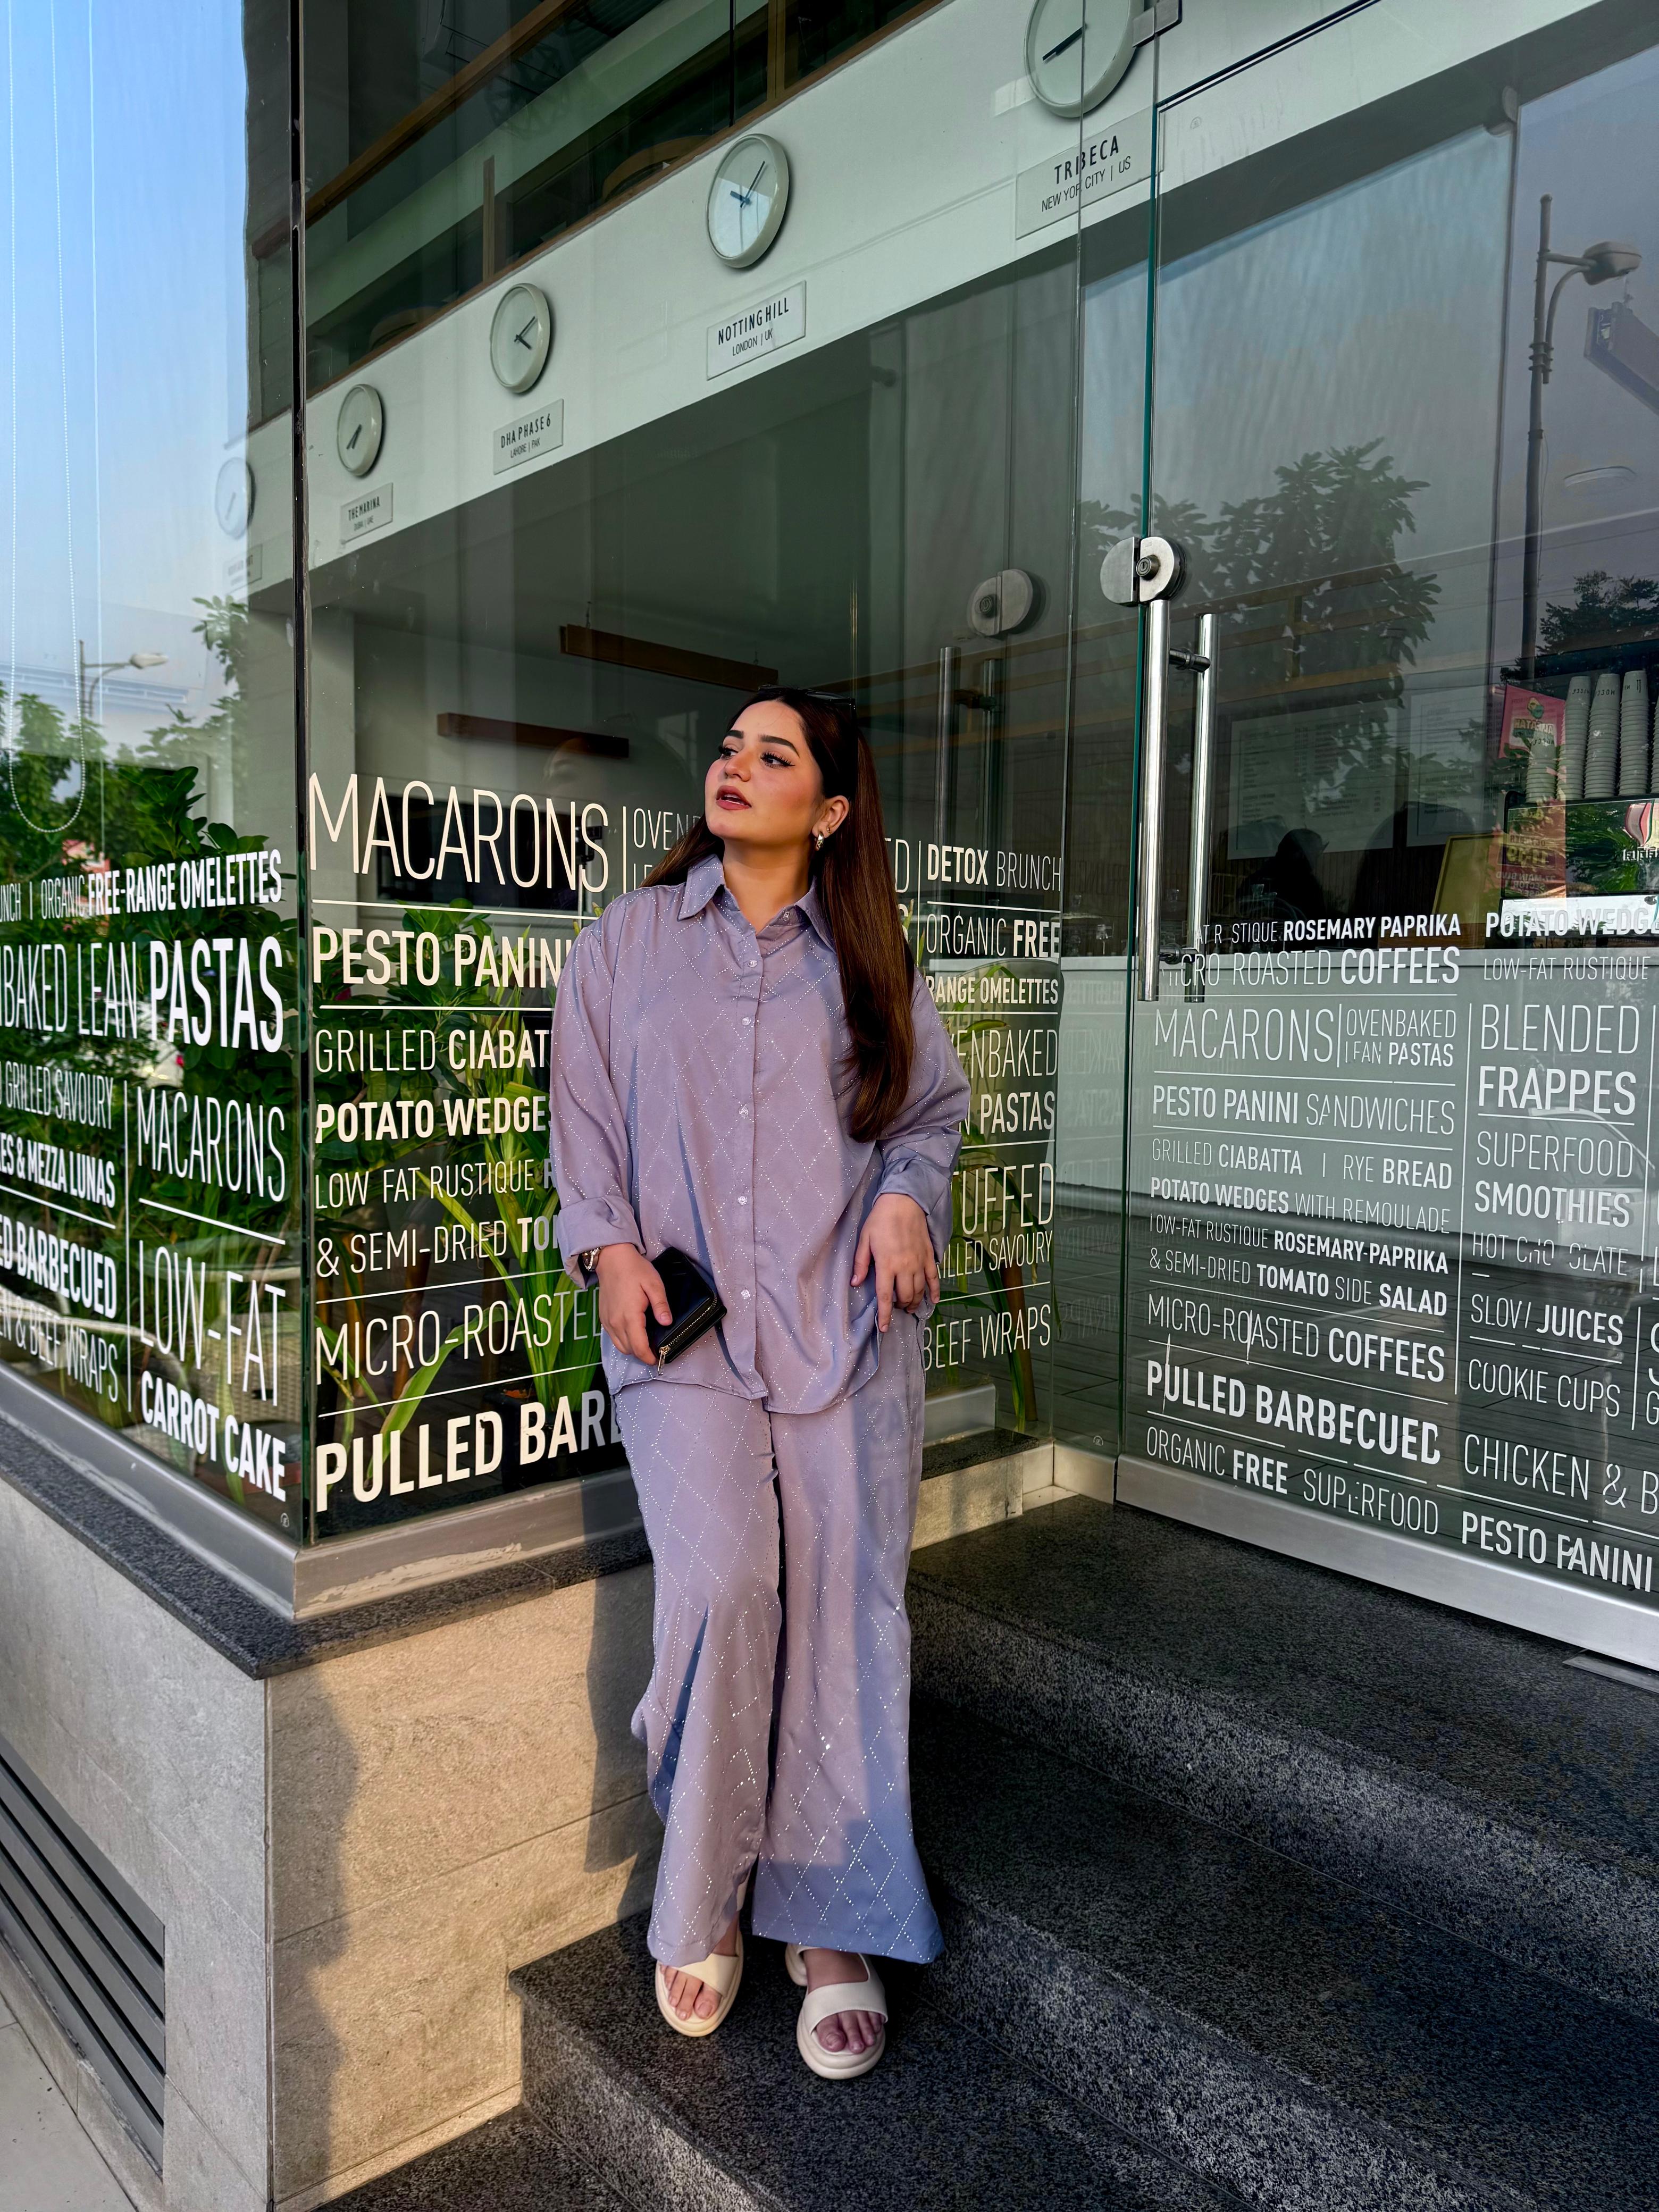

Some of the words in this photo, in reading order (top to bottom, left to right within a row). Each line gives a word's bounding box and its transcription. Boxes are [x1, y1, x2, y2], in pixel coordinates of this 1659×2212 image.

[1041, 192, 1061, 212] NEW
[1085, 169, 1105, 189] CITY
[1119, 156, 1131, 173] US
[1054, 136, 1119, 184] TRIBECA
[718, 309, 763, 345] NOTTING
[765, 297, 789, 323] HILL
[732, 334, 758, 356] LONDON
[765, 328, 773, 342] UK
[501, 429, 516, 449] DHA
[518, 416, 544, 441] PHASE
[546, 413, 551, 428] 6
[309, 773, 608, 893] MACARONS
[633, 808, 701, 851] OVEN
[41, 875, 85, 919] ORGANIC
[88, 862, 176, 916] FREE-RANGE
[180, 849, 281, 909] OMELETTES
[927, 843, 989, 885] DETOX
[996, 851, 1061, 892] BRUNCH
[926, 914, 1007, 957] ORGANIC
[1013, 920, 1060, 958] FREE
[1283, 917, 1376, 941] ROSEMARY
[1380, 913, 1462, 938] PAPRIKA
[1485, 910, 1568, 938] POTATO
[312, 926, 440, 987] PESTO
[455, 934, 572, 988] PANIN
[1233, 949, 1331, 986] ROASTED
[1340, 946, 1460, 985] COFFEES
[1484, 957, 1557, 981] LOW-FAT
[1563, 956, 1650, 981] RUSTIQUE
[0, 944, 67, 1033] BAKED
[78, 941, 137, 1040] LEAN
[150, 936, 283, 1052] PASTAS
[926, 975, 976, 1003] RANGE
[980, 977, 1059, 1004] OMELETTES
[1154, 1008, 1334, 1063] MACARONS
[1346, 1009, 1456, 1038] OVENBAKED
[1480, 1003, 1639, 1054] BLENDED
[316, 1029, 436, 1074] GRILLED
[951, 1028, 1058, 1078] ENBAKED
[1388, 1042, 1454, 1067] PASTAS
[4, 1060, 51, 1117] GRILLED
[55, 1069, 113, 1130] SAVOURY
[980, 1090, 1055, 1134] PASTAS
[1153, 1084, 1217, 1119] PESTO
[1224, 1088, 1298, 1124] PANINI
[1306, 1093, 1456, 1135] SANDWICHES
[1478, 1065, 1637, 1116] FRAPPES
[138, 1086, 285, 1202] MACARONS
[315, 1099, 434, 1144] POTATO
[443, 1095, 551, 1136] WEDGE
[16, 1138, 26, 1180] &
[27, 1139, 68, 1193] MEZZA
[70, 1151, 115, 1209] LUNAS
[1152, 1138, 1212, 1166] GRILLED
[1218, 1144, 1302, 1176] CIABATTA
[1343, 1154, 1375, 1183] RYE
[1383, 1158, 1452, 1189] BREAD
[1476, 1130, 1634, 1178] SUPERFOOD
[315, 1170, 369, 1210] LOW
[382, 1167, 420, 1204] FAT
[430, 1159, 534, 1200] RUSTIQUE
[951, 1162, 1054, 1235] UFFED
[1150, 1176, 1209, 1204] POTATO
[1214, 1184, 1289, 1214] WEDGES
[1295, 1193, 1335, 1221] WITH
[1343, 1196, 1451, 1234] REMOULADE
[1474, 1179, 1630, 1228] SMOOTHIES
[316, 1237, 341, 1278] &
[350, 1220, 508, 1273] SEMI-DRIED
[517, 1216, 559, 1253] TO
[937, 1239, 984, 1280] ILLED
[988, 1230, 1053, 1271] SAVOURY
[1206, 1220, 1268, 1250] RUSTIQUE
[1472, 1231, 1509, 1260] HOT
[16, 1220, 116, 1319] BARBECUED
[1150, 1247, 1161, 1270] &
[1165, 1250, 1251, 1284] SEMI-DRIED
[1256, 1263, 1329, 1297] TOMATO
[1335, 1276, 1372, 1305] SIDE
[1379, 1283, 1447, 1316] SALAD
[139, 1239, 286, 1406] LOW-FAT
[924, 1318, 973, 1371] BEEF
[980, 1303, 1051, 1359] WRAPS
[1148, 1294, 1319, 1358] MICRO-ROASTED
[1329, 1327, 1445, 1382] COFFEES
[1536, 1304, 1623, 1346] JUICES
[15, 1295, 27, 1350] &
[30, 1304, 60, 1368] BEEF
[64, 1321, 118, 1403] WRAPS
[1147, 1360, 1246, 1418] PULLED
[1256, 1384, 1441, 1465] BARBECUED
[1468, 1359, 1548, 1404] COOKIE
[1557, 1375, 1620, 1418] CUPS
[141, 1370, 220, 1462] CARROT
[225, 1414, 286, 1502] CAKE
[316, 1410, 503, 1513] PULLED
[1146, 1426, 1225, 1476] ORGANIC
[1233, 1449, 1288, 1495] FREE
[1464, 1434, 1590, 1501] CHICKEN
[1602, 1463, 1626, 1509] &
[1462, 1510, 1546, 1564] PESTO
[1557, 1534, 1653, 1593] PANINI
